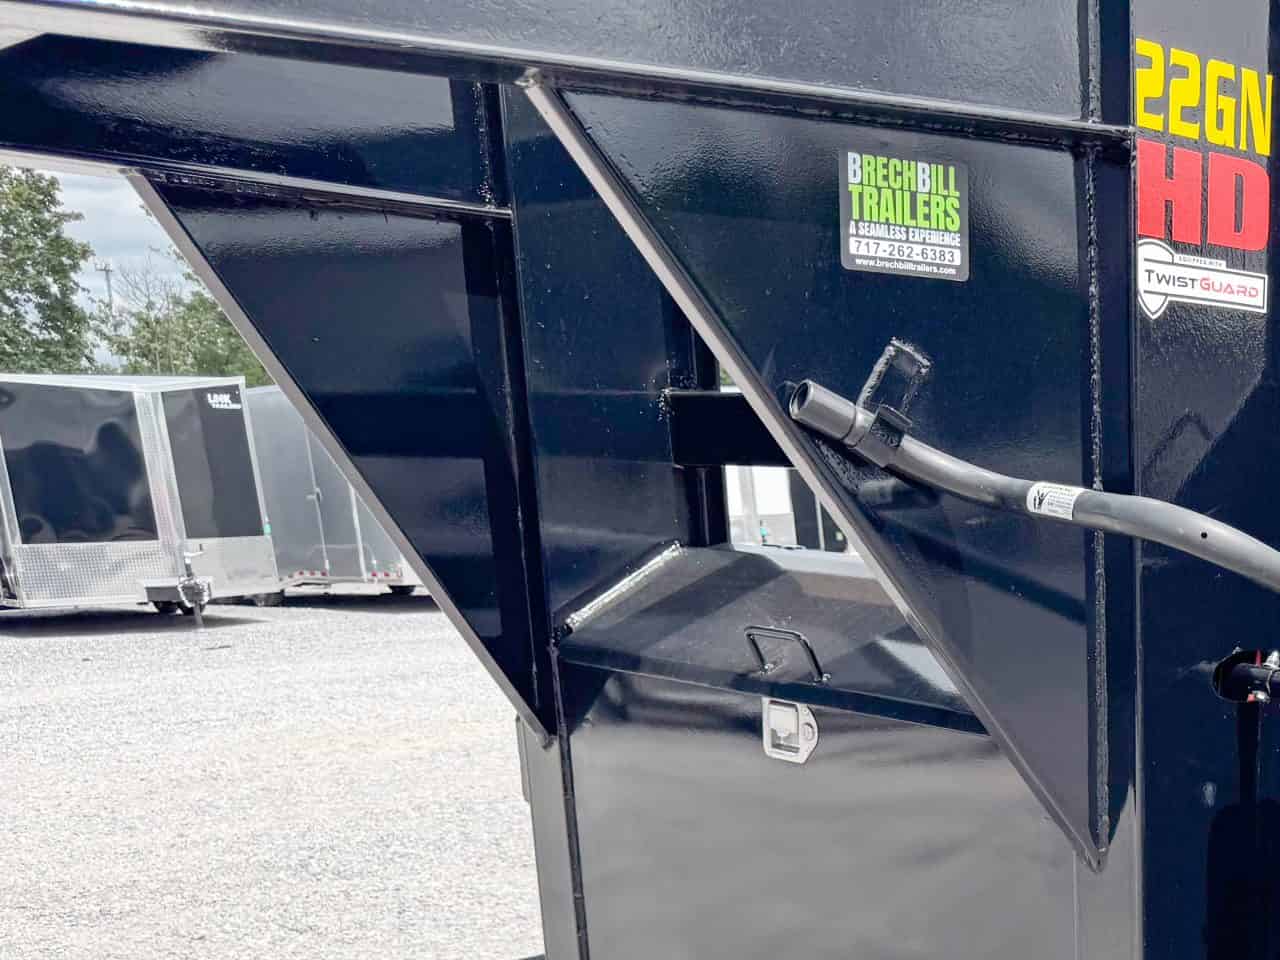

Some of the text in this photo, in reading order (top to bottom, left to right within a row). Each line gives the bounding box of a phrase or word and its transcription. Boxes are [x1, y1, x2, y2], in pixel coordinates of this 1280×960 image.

[1135, 38, 1273, 157] 22GN
[848, 152, 960, 197] BRECHBILL
[848, 184, 961, 232] TRAILERS
[1136, 138, 1271, 251] HD
[849, 220, 961, 247] A SEAMLESS EXPERIENCE
[854, 240, 955, 263] 717-262-6383
[855, 258, 957, 275] www.brechbilltrailers.com
[1144, 268, 1259, 298] TWISTGUARD
